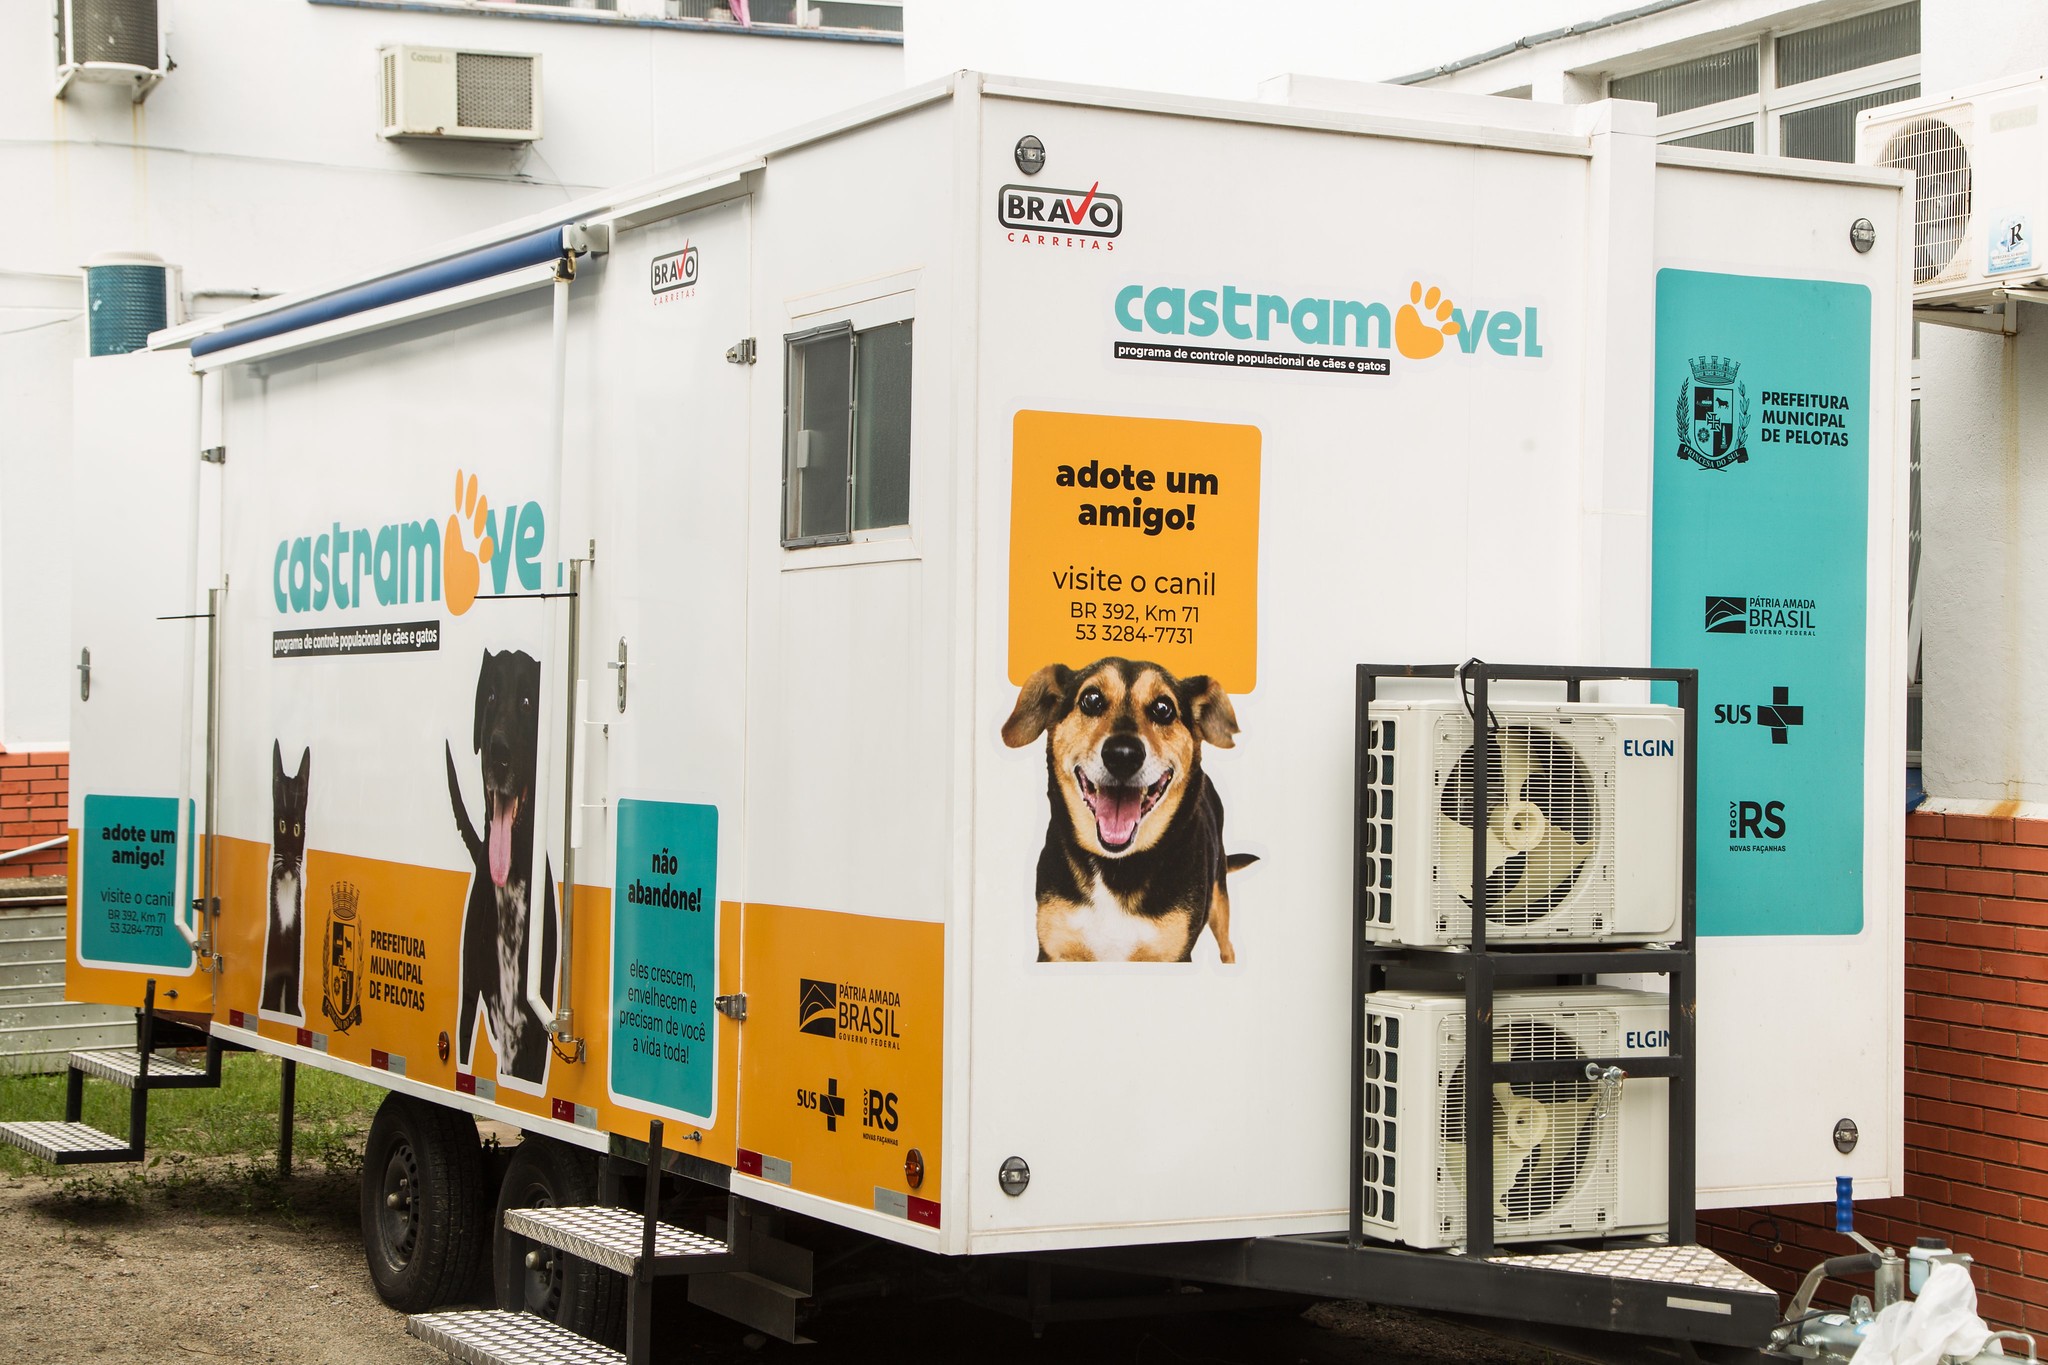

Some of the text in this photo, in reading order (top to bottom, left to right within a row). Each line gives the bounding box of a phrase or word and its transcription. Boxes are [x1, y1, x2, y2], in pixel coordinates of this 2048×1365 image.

[1008, 182, 1114, 228] BRAVO
[1007, 233, 1114, 251] CARRETAS
[654, 239, 695, 286] BRAVO
[653, 288, 695, 306] CARRETAS
[1118, 345, 1386, 373] programa de controle populacional de cães e gatos
[1762, 391, 1849, 410] PREFEITURA
[1762, 410, 1845, 428] MUNICIPAL
[1761, 428, 1849, 447] DE PELOTAS
[1683, 446, 1740, 468] PRINCESA DO SUL
[1056, 460, 1218, 495] adote um
[1078, 497, 1196, 536] amigo!
[1052, 565, 1215, 596] visite o canil
[1070, 602, 1199, 624] BR 392, Km 71
[1749, 595, 1816, 609] PÁTRIA AMADA
[1749, 609, 1816, 629] BRASIL
[274, 627, 437, 654] programa de controle populacional de cães e gatos
[1075, 624, 1193, 644] 53 3284-7731
[1714, 704, 1752, 724] SUS
[1624, 740, 1674, 757] ELGIN
[1739, 800, 1786, 839] RS
[102, 823, 175, 844] adote um
[112, 845, 165, 870] amigo!
[652, 847, 678, 875] não
[1752, 845, 1786, 854] FAÇANHAS
[100, 888, 174, 907] visite o canil
[628, 879, 702, 912] abandone!
[108, 909, 166, 923] BR 392, Km 71
[110, 923, 163, 936] 53 3284-7731
[370, 930, 426, 959] PREFEITURA
[370, 955, 423, 985] MUNICIPAL
[630, 959, 696, 992] eles crescem,
[369, 980, 425, 1012] DE PELOTAS
[628, 987, 697, 1015] envelhecem e
[839, 981, 900, 1007] PÁTRIA AMADA
[620, 1009, 706, 1042] precisam de você
[839, 1001, 900, 1038] BRASIL
[633, 1036, 689, 1065] a vida toda!
[839, 1032, 900, 1050] GOVERNO FEDERAL
[797, 1088, 816, 1110] SUS
[869, 1089, 898, 1132] RS
[863, 1132, 876, 1142] NOVAS
